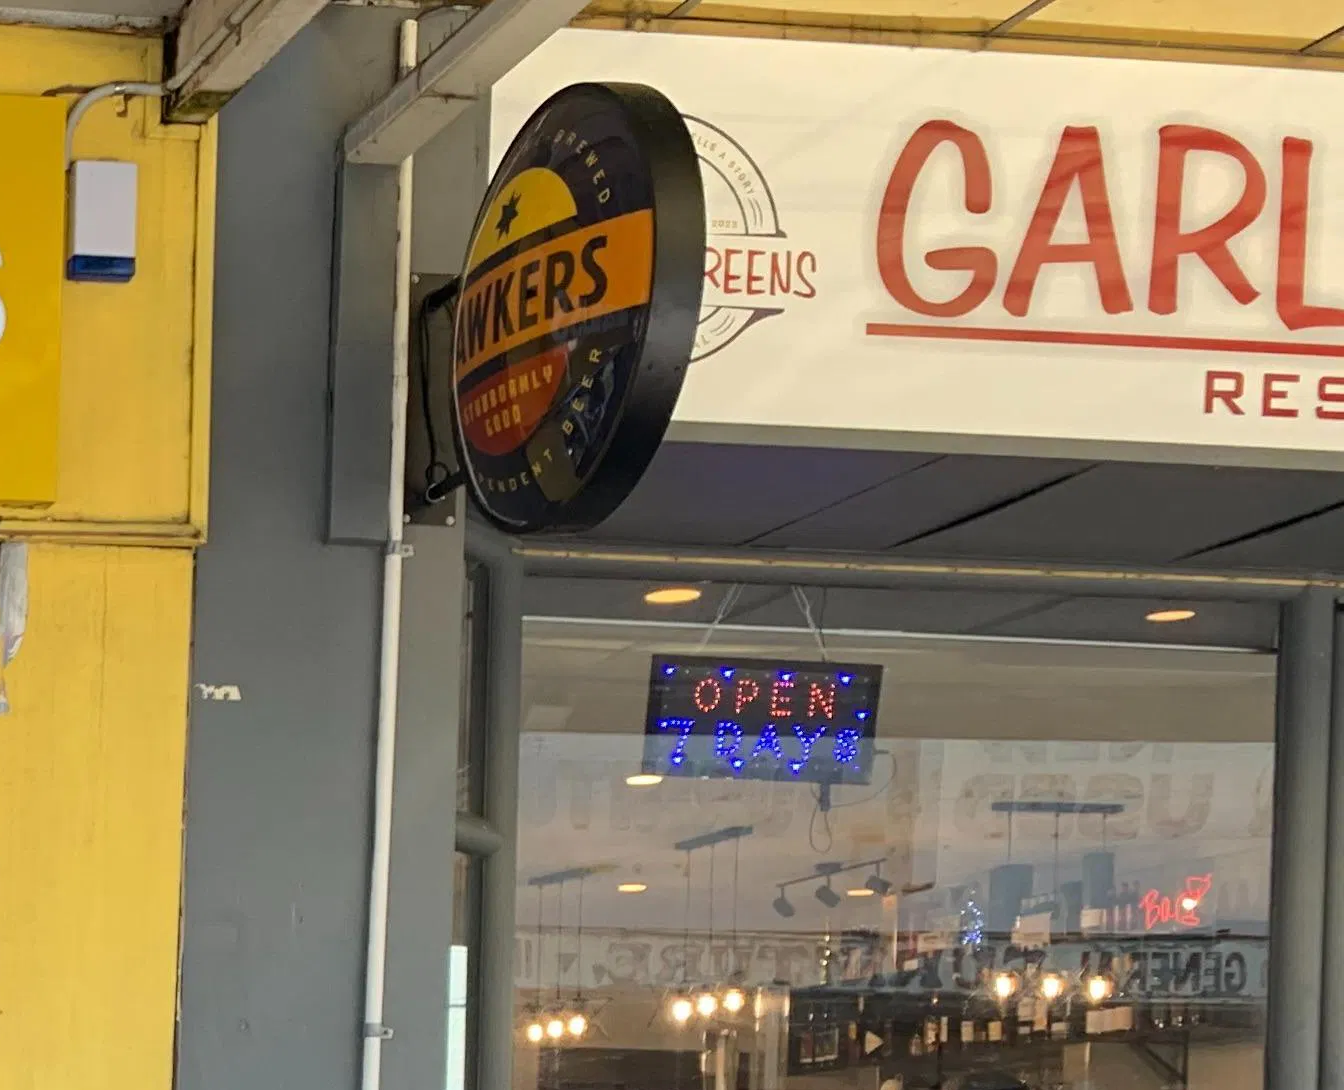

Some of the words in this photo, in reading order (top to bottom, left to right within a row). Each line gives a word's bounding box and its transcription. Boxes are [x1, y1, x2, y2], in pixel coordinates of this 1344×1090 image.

[555, 128, 610, 205] BREWED
[876, 119, 1344, 331] GARL
[562, 347, 602, 435] BEER
[485, 408, 522, 438] GOOD
[694, 677, 836, 719] OPEN
[657, 717, 696, 756] 7
[716, 721, 859, 763] DAYS
